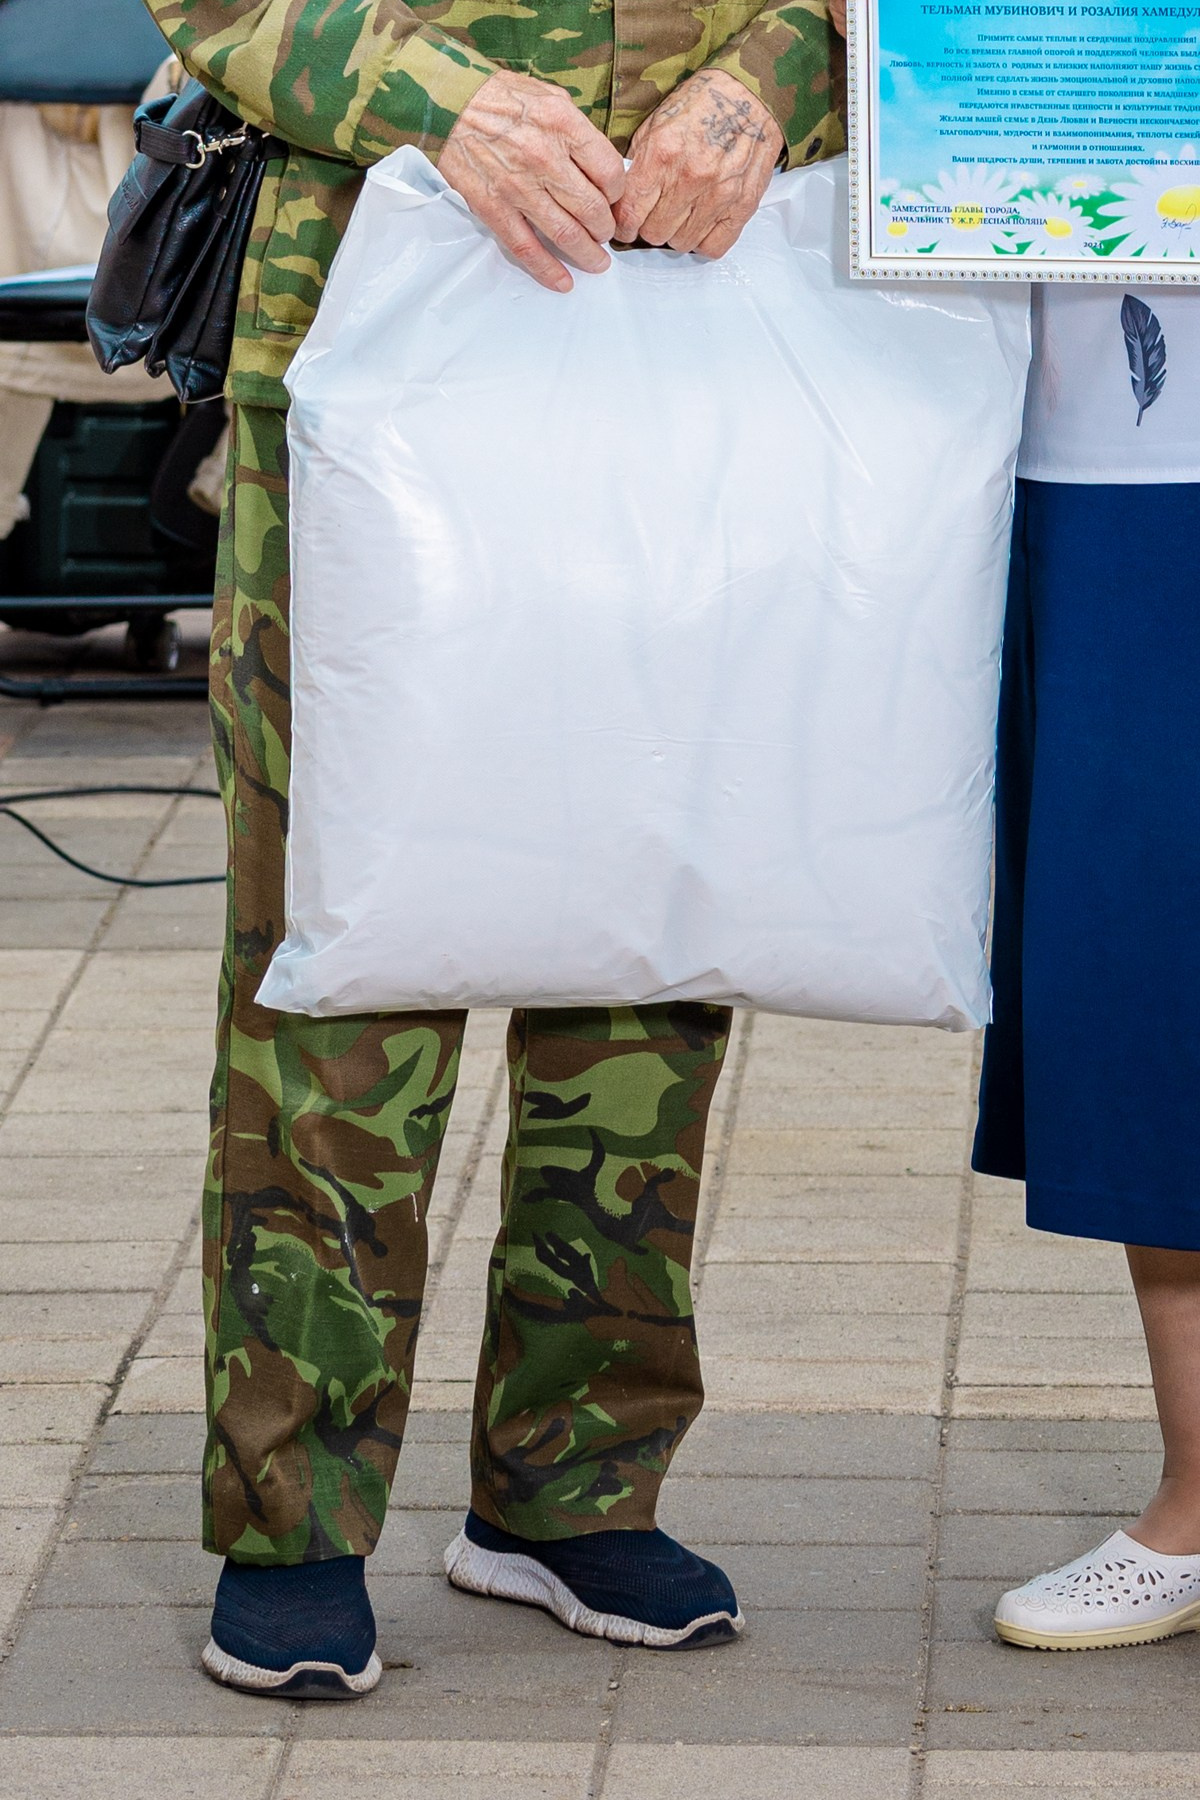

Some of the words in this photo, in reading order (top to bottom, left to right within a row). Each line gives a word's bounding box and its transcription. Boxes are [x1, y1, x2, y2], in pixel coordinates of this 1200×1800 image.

[921, 5, 981, 15] ТЕЛЬМАН
[985, 5, 1064, 16] МУБИНОВИЧ
[1068, 6, 1077, 16] И
[1081, 6, 1138, 17] РОЗАЛИЯ
[891, 205, 952, 213] ЗАМЕСТИТЕЛЬ
[954, 206, 983, 214] ГЛАВЫ
[985, 206, 1020, 215] ГОРОДА,
[892, 216, 943, 224] НАЧАЛЬНИК
[977, 217, 1010, 225] ЛЕСНАЯ
